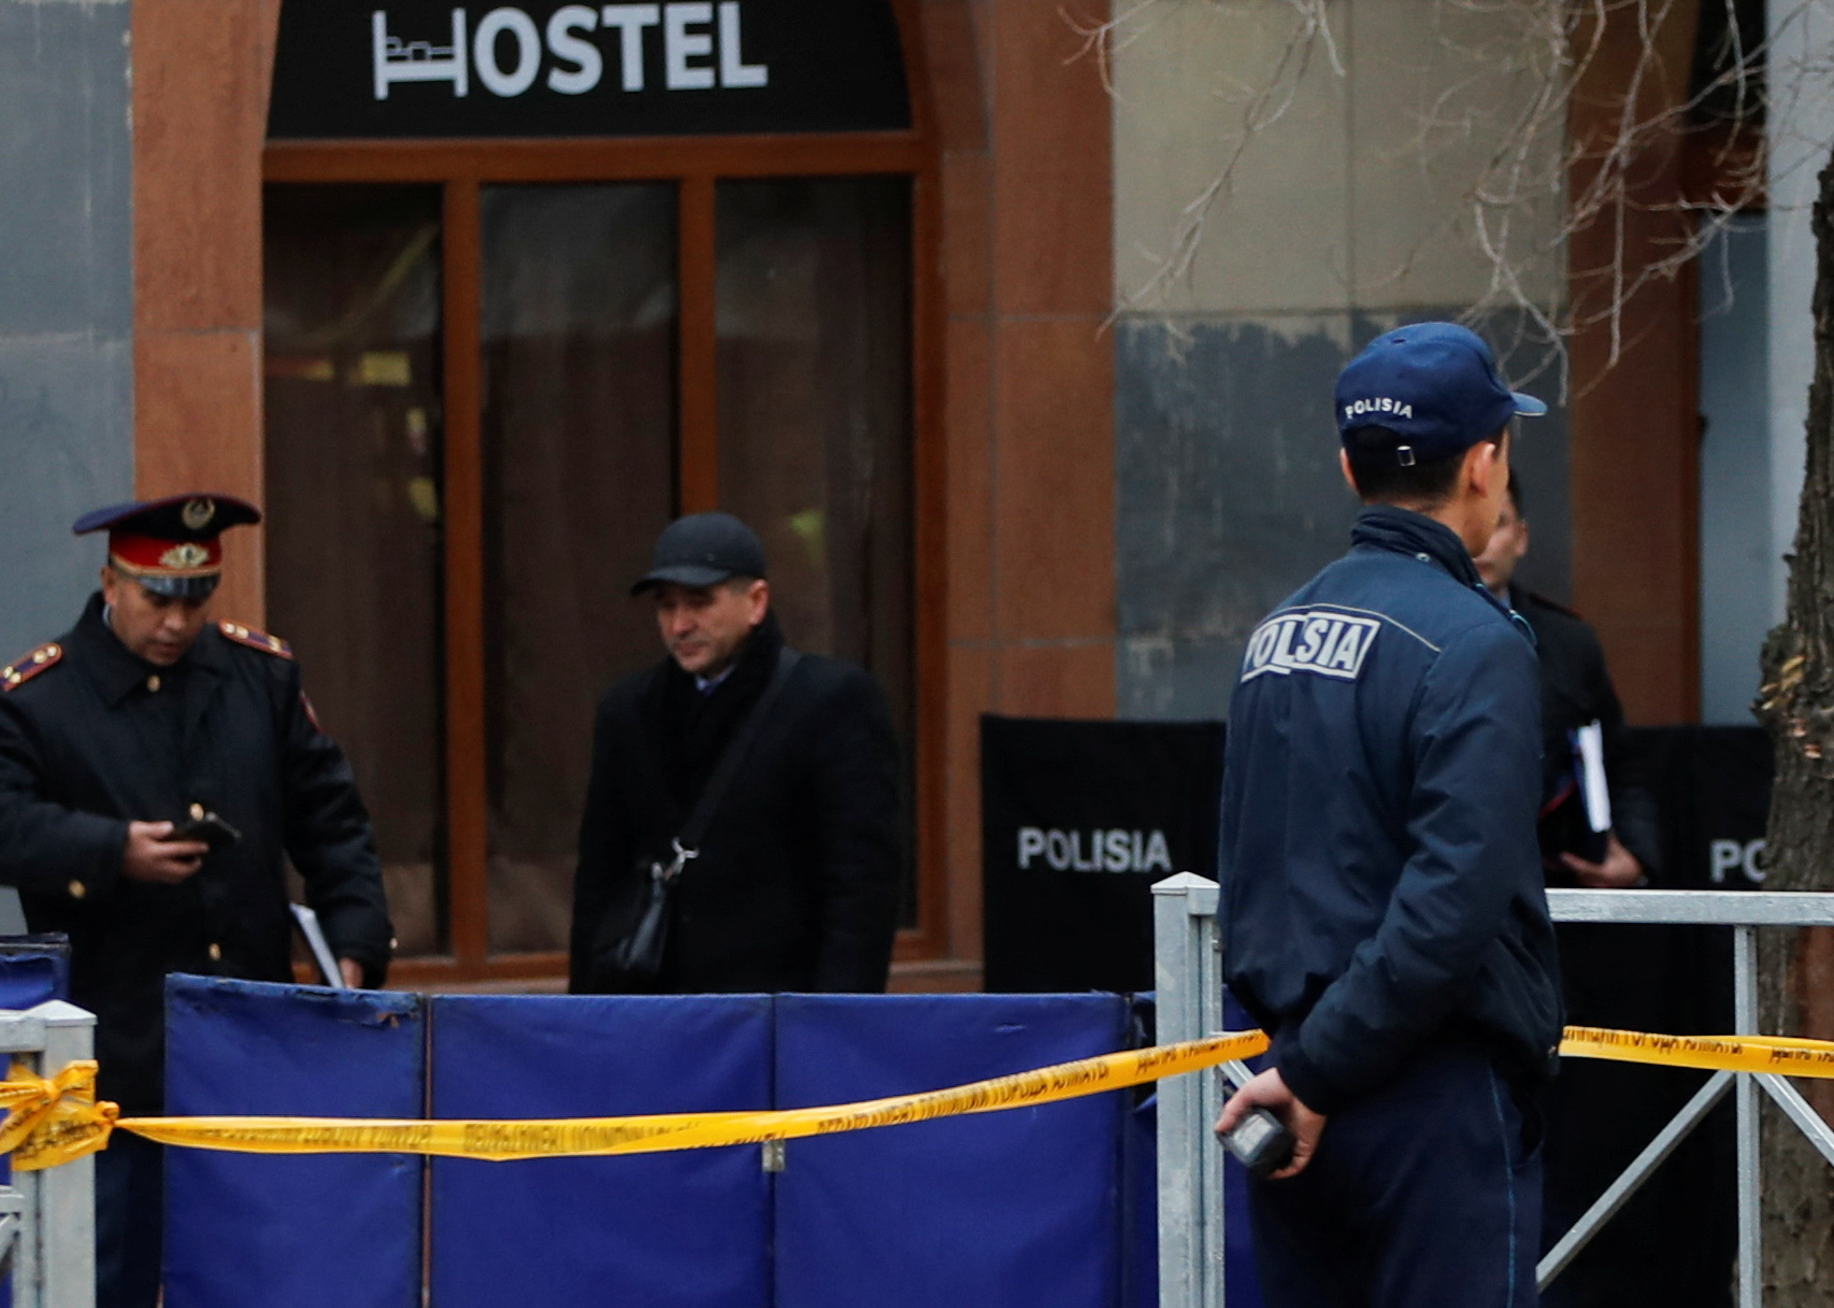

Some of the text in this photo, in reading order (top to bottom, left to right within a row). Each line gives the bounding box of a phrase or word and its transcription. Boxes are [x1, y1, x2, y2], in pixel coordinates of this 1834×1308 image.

[371, 0, 768, 101] HOSTEL
[1344, 396, 1413, 420] POLISIA
[1242, 618, 1365, 671] POLSIA
[1017, 826, 1173, 873] POLISIA
